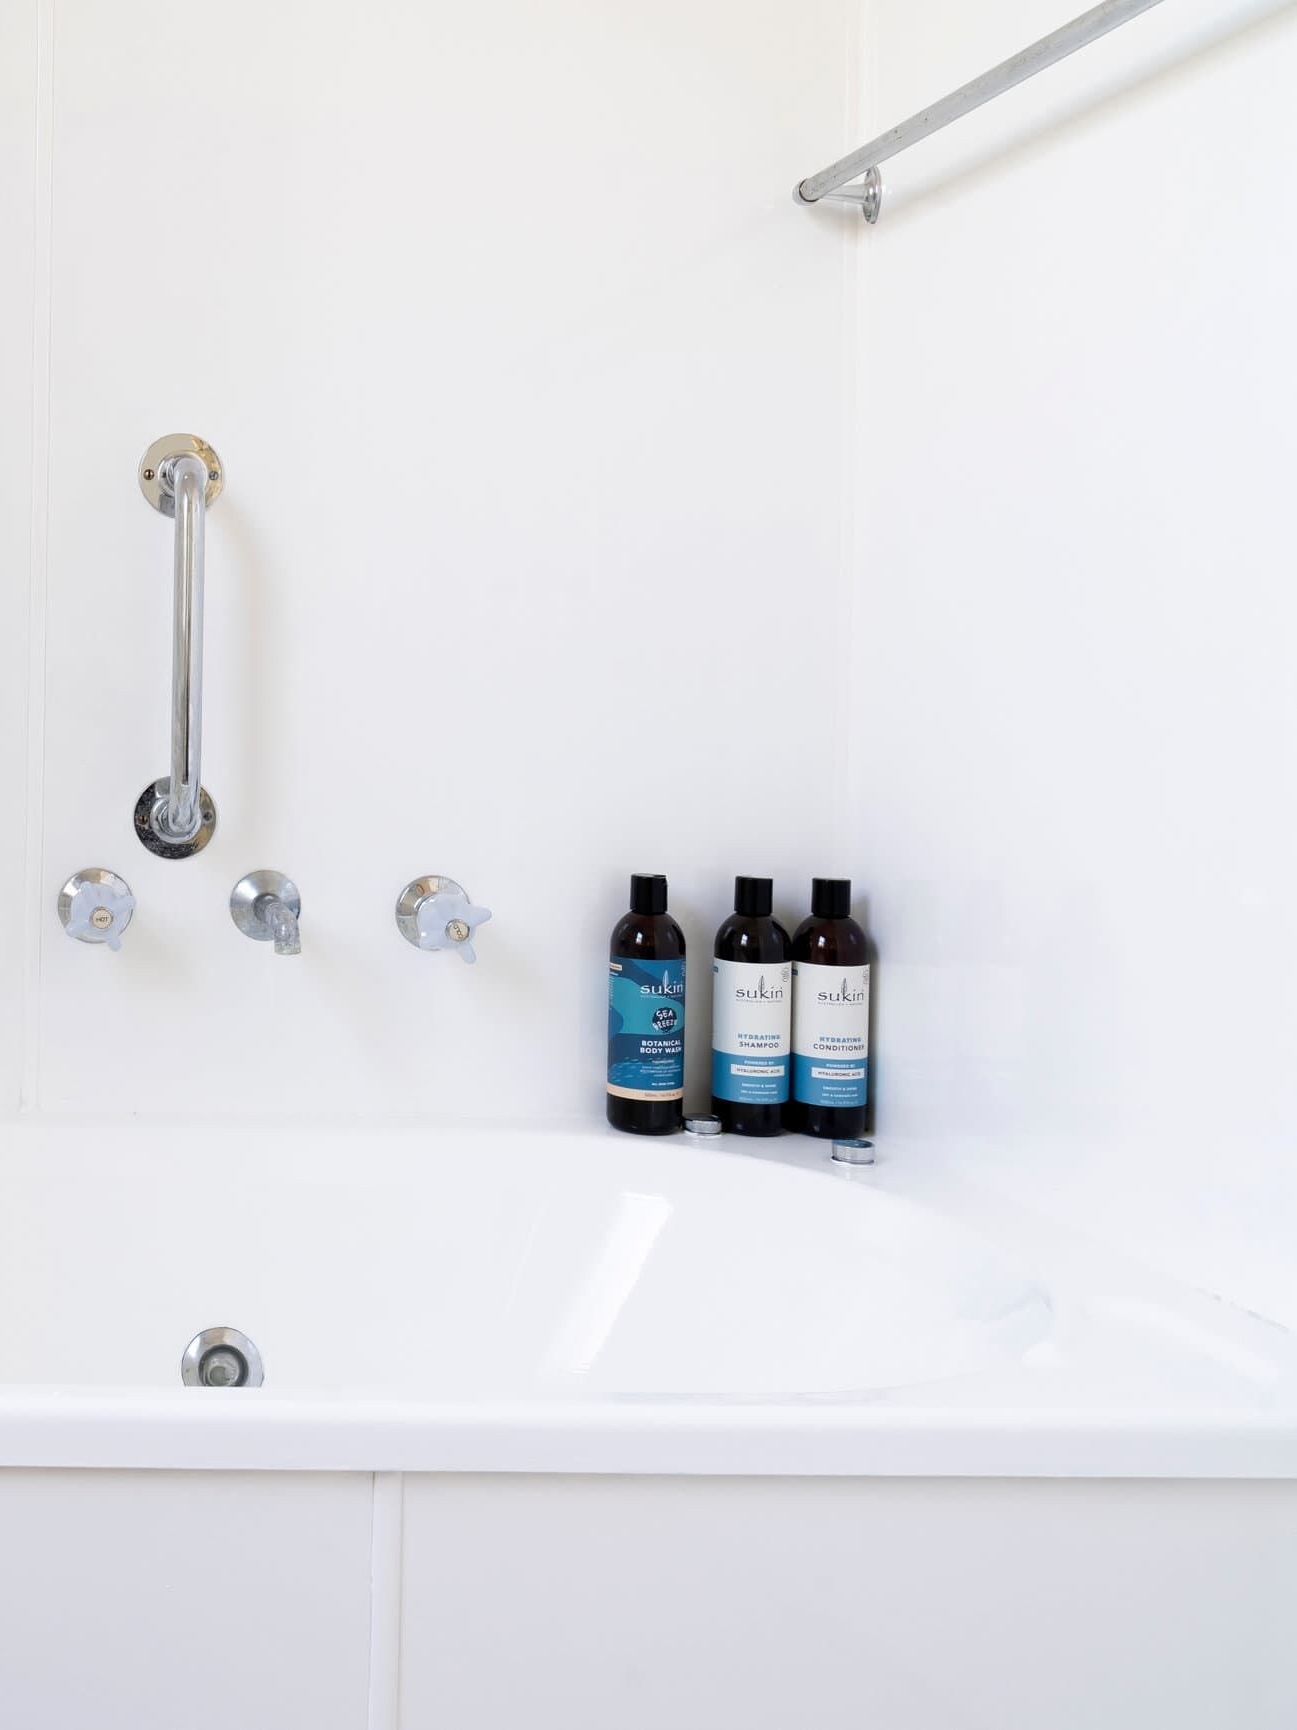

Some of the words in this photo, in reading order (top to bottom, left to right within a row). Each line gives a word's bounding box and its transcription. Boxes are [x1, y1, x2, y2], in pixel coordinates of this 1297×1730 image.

[640, 969, 683, 995] sukin
[736, 975, 783, 999] sukin
[817, 977, 864, 1002] sukin
[656, 1009, 674, 1020] SEA
[641, 1039, 681, 1047] BOTANICAL
[739, 1041, 779, 1049] SHAMPOO
[813, 1043, 864, 1051] CONDITIONER
